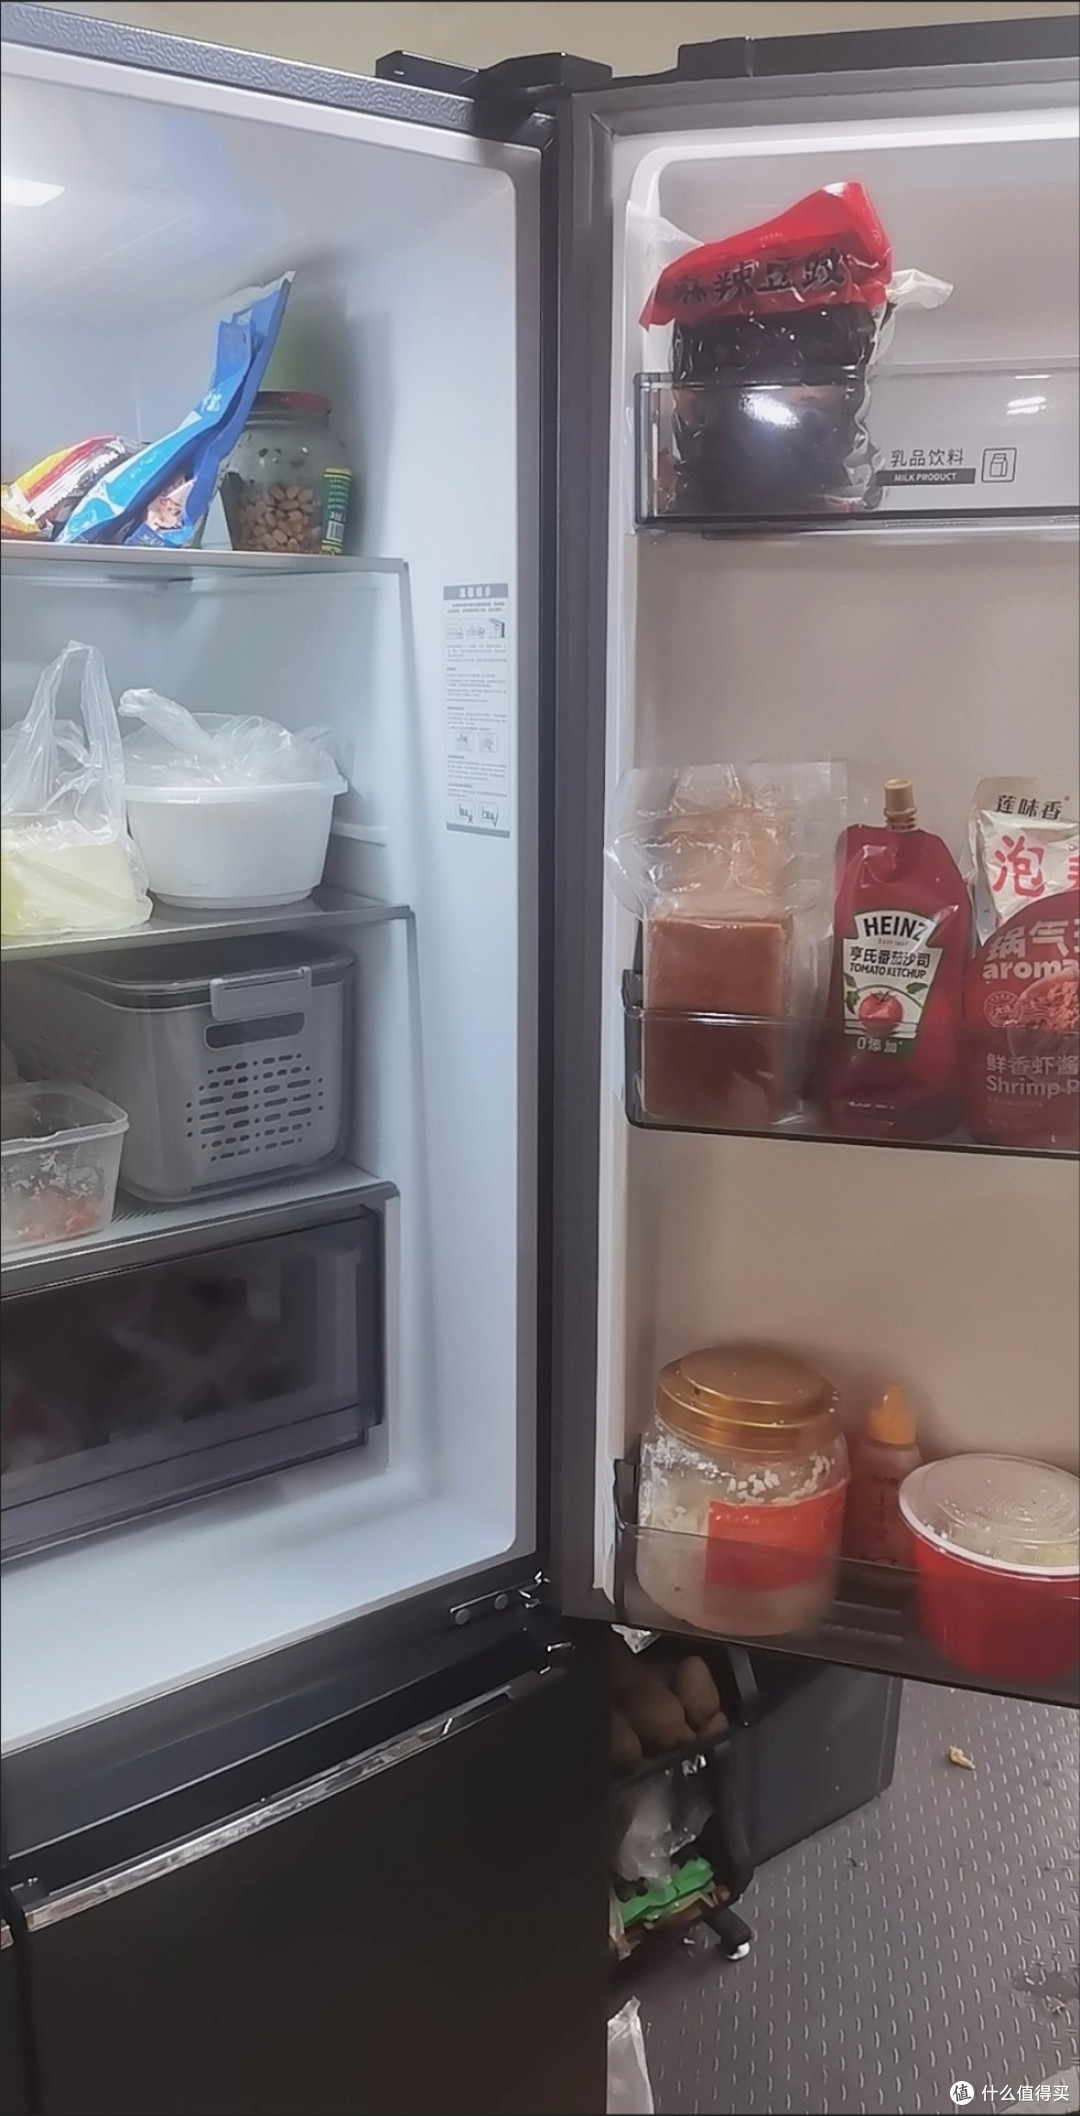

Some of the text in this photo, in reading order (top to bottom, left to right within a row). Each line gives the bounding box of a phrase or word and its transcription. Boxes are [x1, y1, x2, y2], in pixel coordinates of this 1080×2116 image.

[890, 449, 964, 468] 乳品饮料
[894, 472, 957, 483] MILK PRODUCT
[996, 795, 1062, 820] 莲味香
[992, 835, 1079, 897] 泡
[863, 916, 928, 942] HEINZ
[986, 919, 1079, 962] 锅气
[850, 946, 931, 968] 亨氏番茄沙司
[849, 962, 927, 979] TOMATO KETCHUP
[986, 1052, 1079, 1075] 鲜香虾酱
[986, 1075, 1060, 1100] Shrimp
